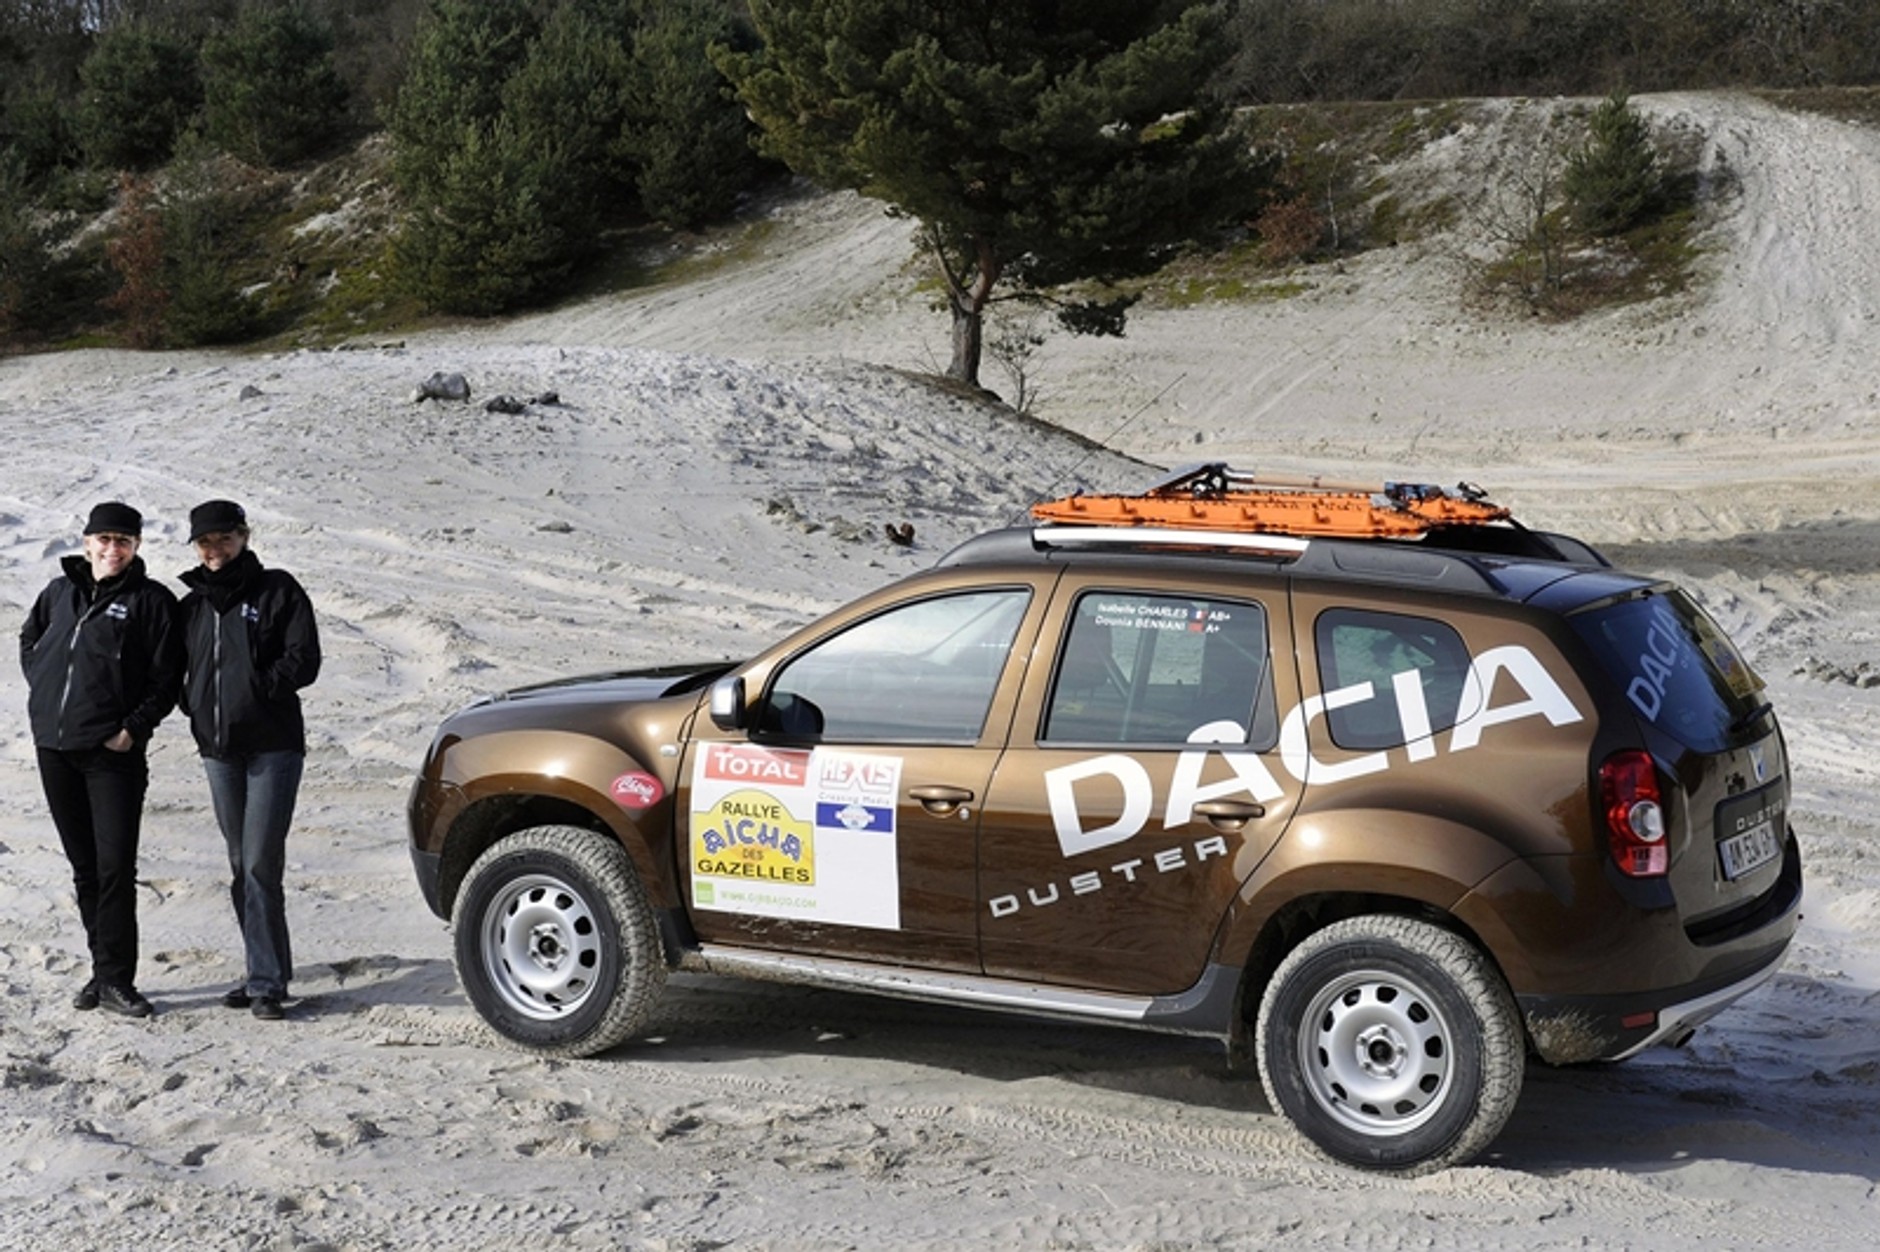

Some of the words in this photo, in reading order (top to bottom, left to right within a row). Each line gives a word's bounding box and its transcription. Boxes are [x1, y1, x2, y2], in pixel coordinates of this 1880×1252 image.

[1135, 617, 1186, 631] BENNANI
[1205, 623, 1220, 634] A+
[1137, 605, 1188, 619] CHARLES
[1208, 610, 1231, 621] AB+
[1626, 604, 1680, 722] DACIA
[1044, 645, 1584, 858] DACIA
[714, 751, 799, 779] TOTAL
[820, 756, 895, 795] HEXIS
[721, 800, 782, 820] RALLYE
[742, 847, 765, 861] DES
[697, 859, 811, 882] GAZELLES
[988, 835, 1229, 918] DUSTER
